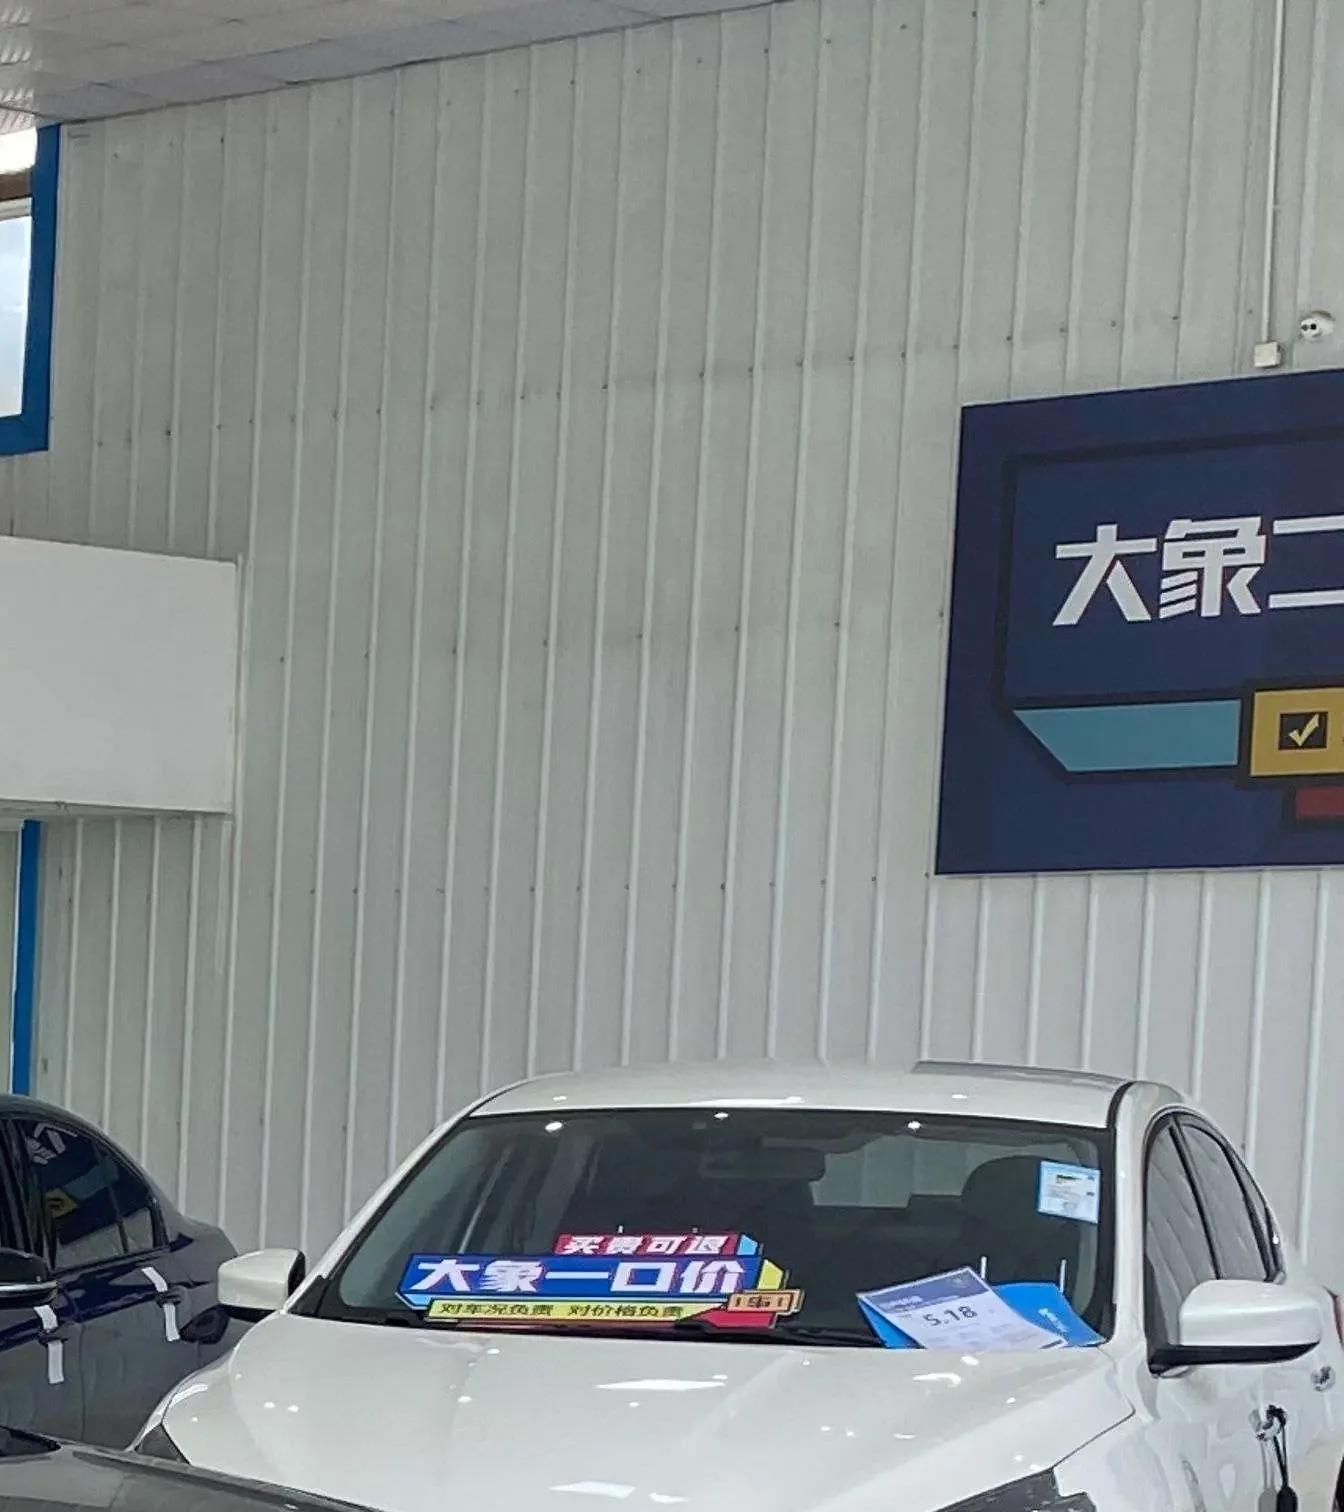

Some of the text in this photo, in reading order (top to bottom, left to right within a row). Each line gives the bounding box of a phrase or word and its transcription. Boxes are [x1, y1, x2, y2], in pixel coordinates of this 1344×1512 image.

[1052, 514, 1344, 627] 大象二
[563, 1236, 729, 1255] 买贵可退
[411, 1258, 744, 1294] 大象一口价
[440, 1303, 685, 1318] 对车况负责 对价格负责
[922, 1305, 979, 1328] 5.18
